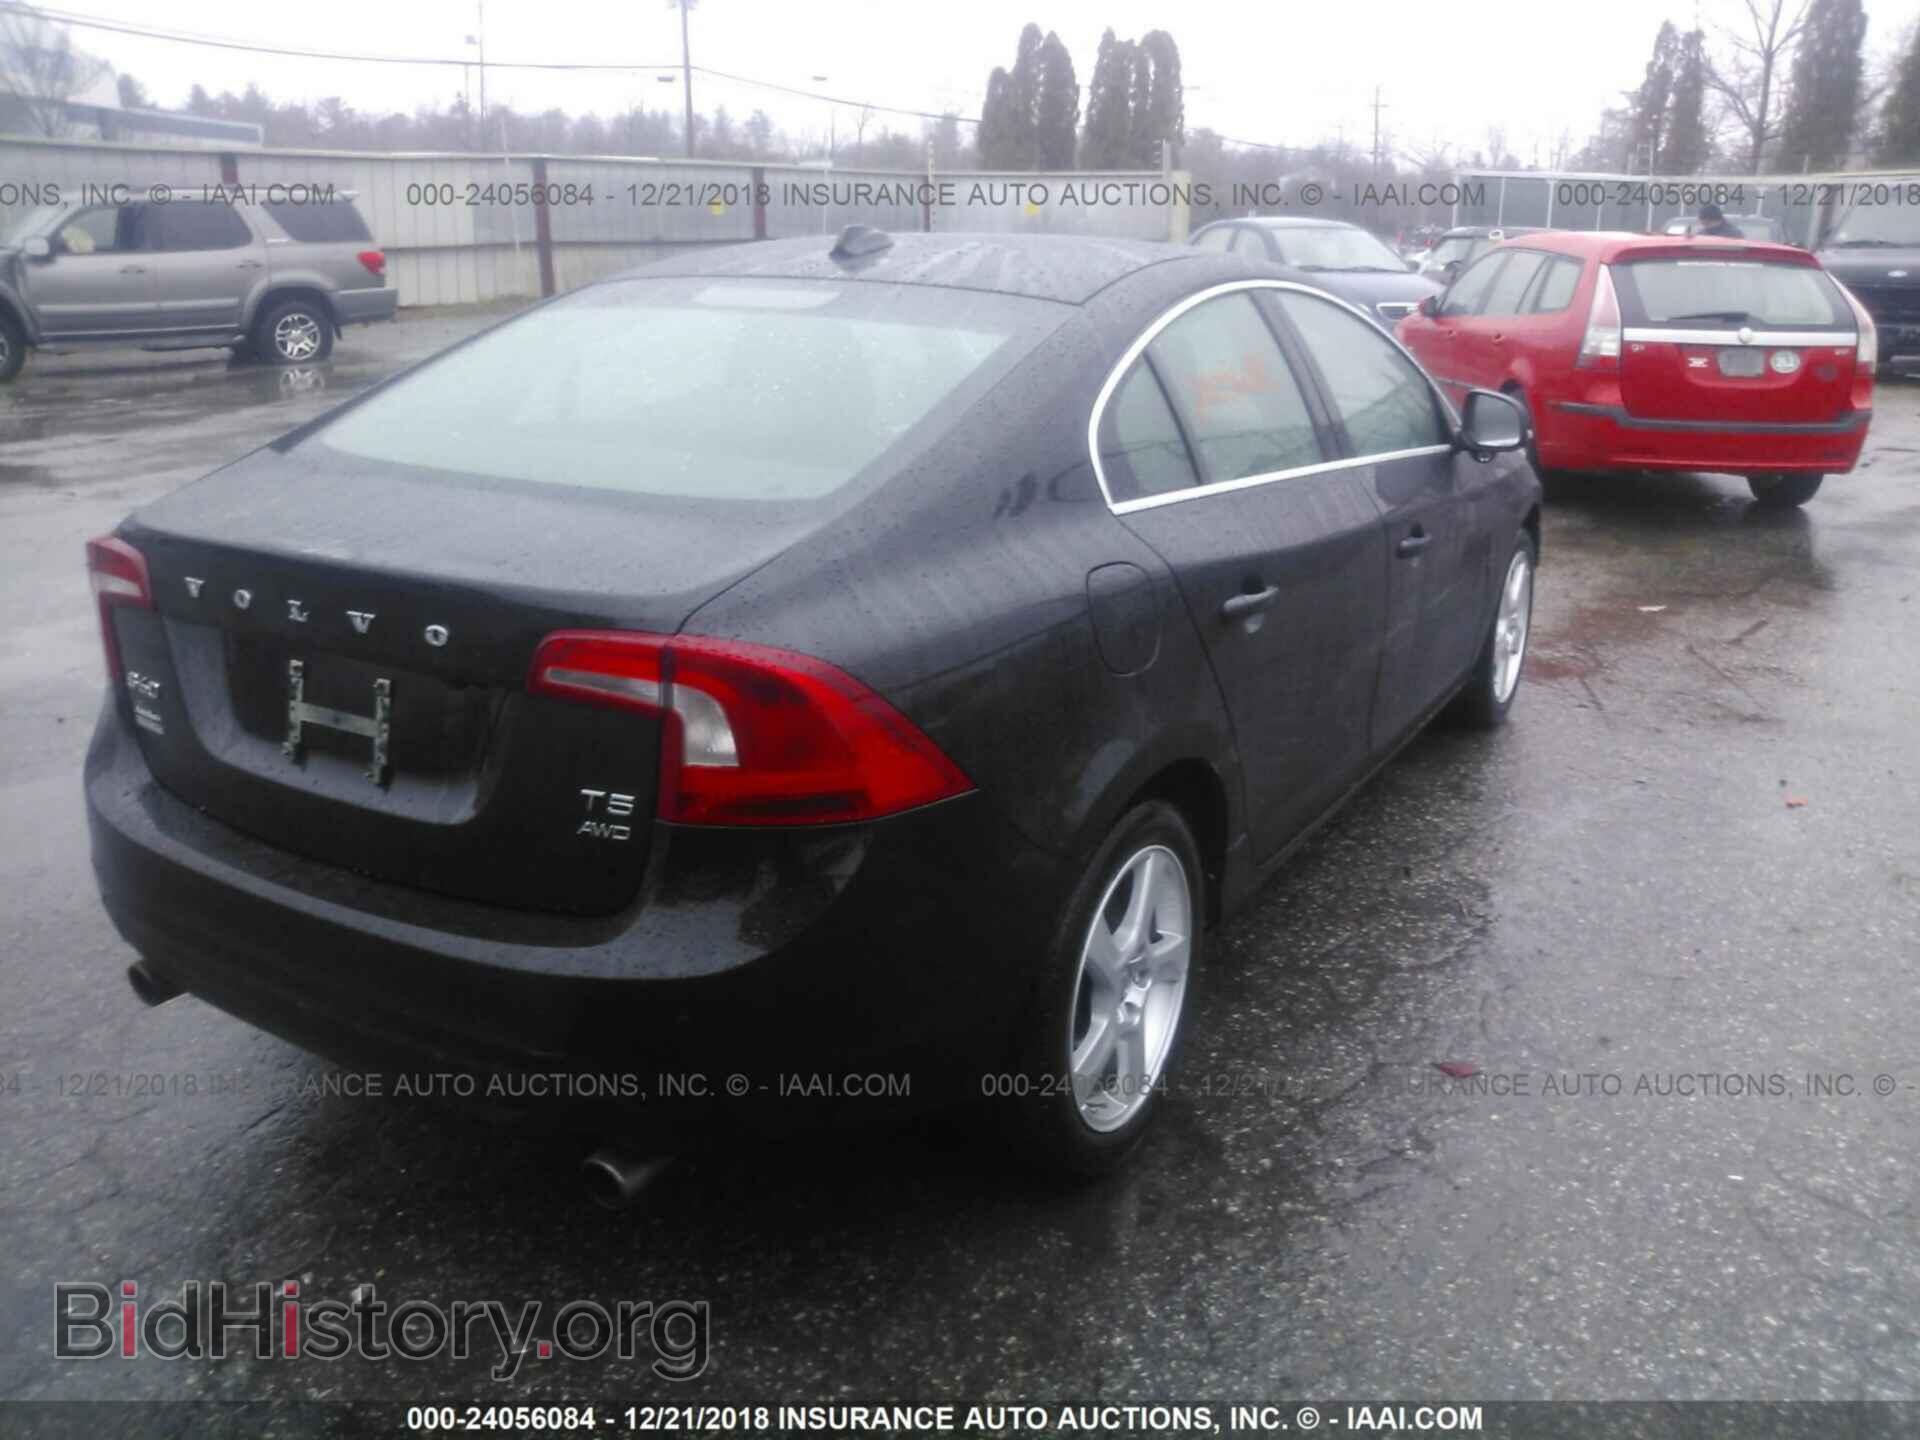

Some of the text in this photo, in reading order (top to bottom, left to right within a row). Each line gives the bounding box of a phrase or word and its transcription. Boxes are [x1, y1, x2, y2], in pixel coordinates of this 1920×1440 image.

[184, 576, 449, 647] VOLVO
[580, 788, 635, 815] T5
[576, 820, 631, 840] AWD
